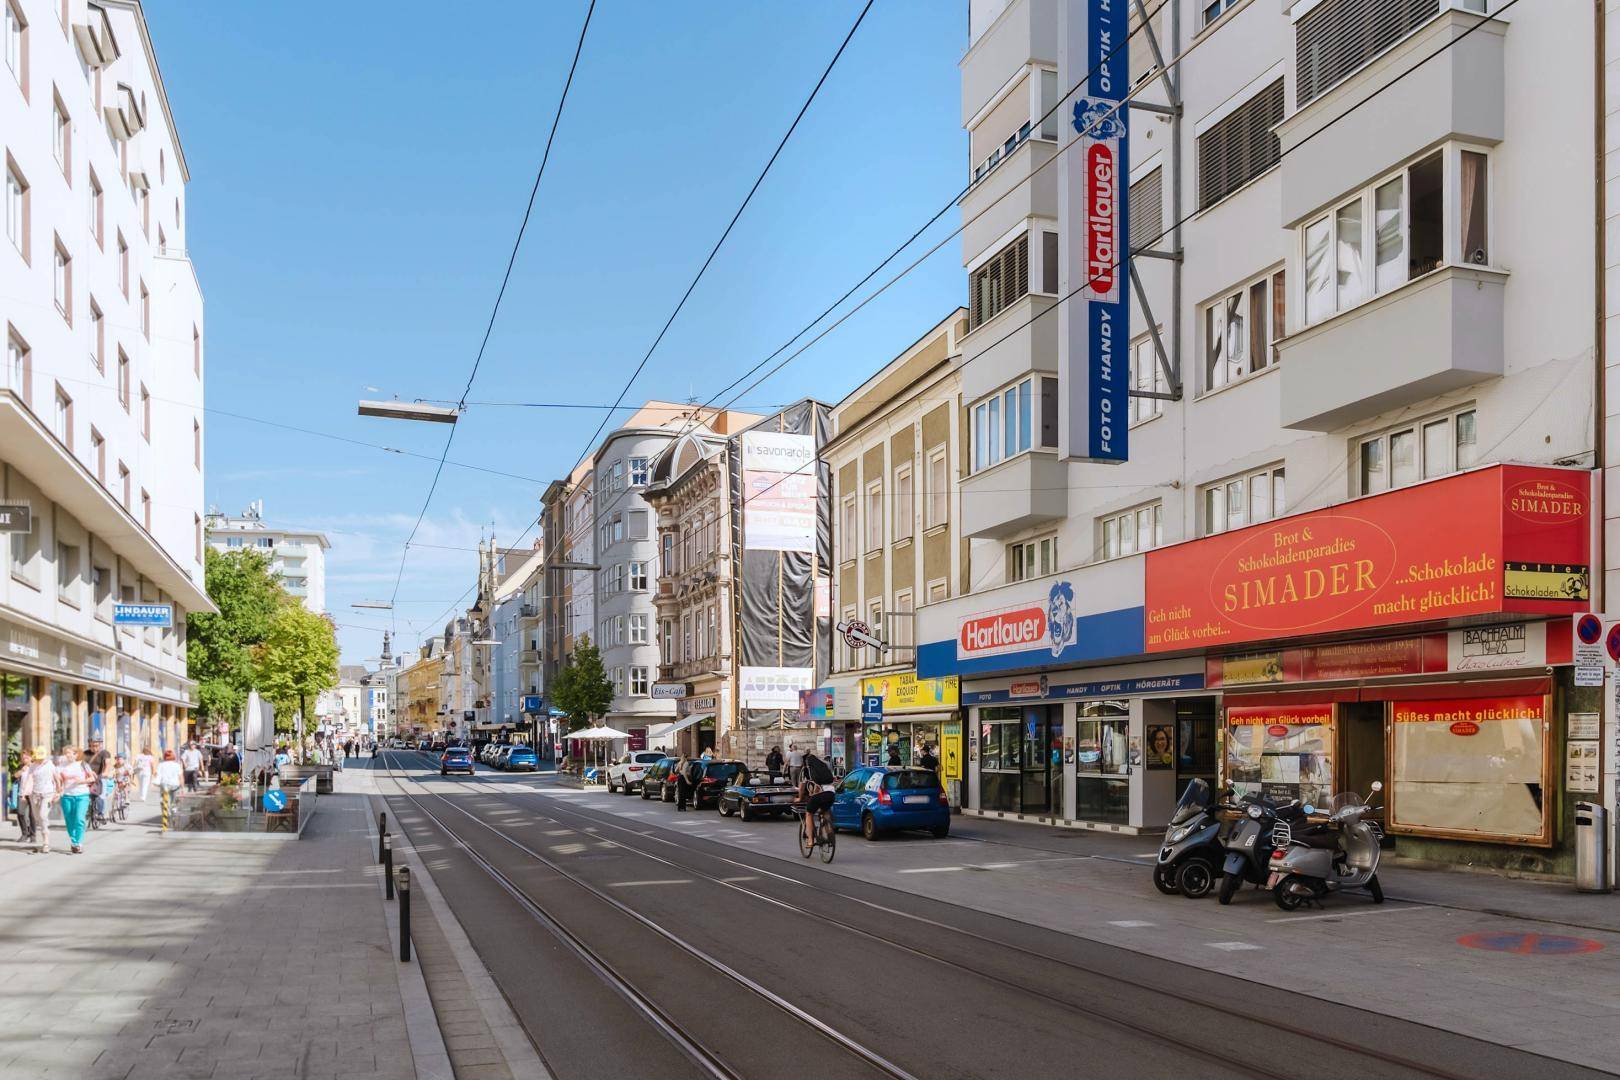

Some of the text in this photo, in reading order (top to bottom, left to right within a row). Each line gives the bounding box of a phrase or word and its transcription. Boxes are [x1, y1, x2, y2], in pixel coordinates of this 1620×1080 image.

[1100, 30, 1112, 93] OPTIK
[1089, 153, 1112, 284] Hartlauer
[1100, 307, 1112, 382] HANDY
[1100, 399, 1112, 454] FOTO
[1536, 482, 1550, 491] Brot
[1511, 498, 1582, 515] SIMADER
[1273, 526, 1313, 548] Brot &
[1237, 537, 1356, 573] Schokoladenparadies
[1505, 563, 1587, 574] zotter
[1223, 558, 1377, 612] SIMADER
[1505, 585, 1559, 598] Schokoladen
[1373, 581, 1496, 616] macht glücklich!
[115, 606, 169, 615] LINDAUER
[1148, 604, 1192, 624] Geh nicht
[966, 616, 1040, 650] Hartlauer
[1148, 621, 1231, 645] am Glück vorbei...
[1465, 626, 1523, 644] BACHHALM
[896, 685, 919, 697] EXQUISIT
[1066, 686, 1089, 695] HANDY
[1100, 683, 1122, 692] OPTIK
[1135, 679, 1181, 689] HÖRGERÄTE
[978, 693, 992, 701] FOTO
[1230, 716, 1244, 725] Geh
[1245, 715, 1264, 725] nicht
[1265, 717, 1277, 725] am
[1278, 715, 1300, 724] Glück
[1396, 707, 1541, 722] Süßes macht glücklich!
